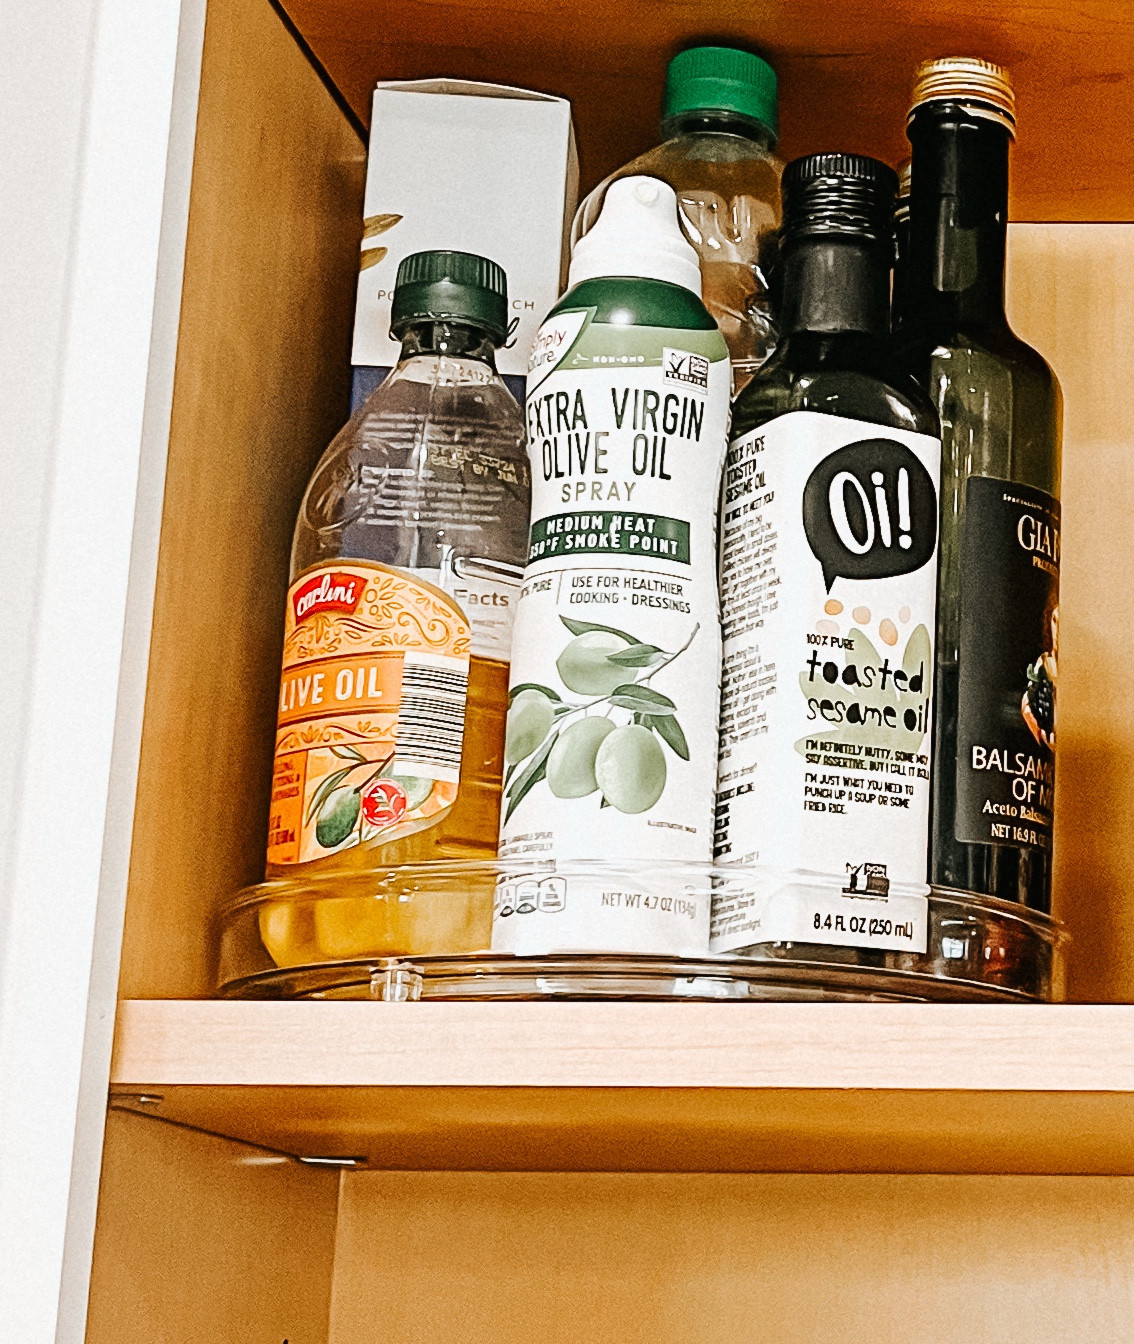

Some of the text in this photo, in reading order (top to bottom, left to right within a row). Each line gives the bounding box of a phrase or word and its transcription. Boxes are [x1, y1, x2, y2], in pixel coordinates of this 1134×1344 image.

[528, 388, 588, 446] EXTRA
[611, 387, 705, 442] VIRGIN
[542, 431, 610, 482] OLIVE
[632, 433, 672, 481] OIL
[745, 435, 766, 456] PURE
[561, 481, 637, 503] SPRAY
[828, 466, 913, 555] Oi!
[546, 515, 656, 535] MEDIUM HEAT
[564, 533, 621, 549] SMOKE
[629, 534, 678, 555] POINT
[296, 573, 356, 617] carlini
[453, 588, 510, 607] Facts
[571, 576, 684, 597] USE FOR HEALTHIER
[569, 592, 692, 614] COOKING DRESSINGS
[830, 636, 855, 651] PURE
[806, 650, 924, 695] toasted
[335, 667, 383, 701] OIL
[807, 697, 929, 734] sesame oil
[819, 775, 840, 786] JUST
[843, 777, 864, 789] WHAT
[867, 779, 883, 792] YOU
[885, 782, 902, 794] NEED
[1012, 777, 1036, 803] OF
[804, 786, 910, 809] PUNCH UP SOUP OR SOME
[804, 801, 827, 812] FRIED
[982, 799, 1018, 817] Aceto
[991, 822, 1011, 839] NET
[602, 892, 673, 912] NET WT 4.7 OZ
[813, 913, 832, 929] 8.4
[835, 915, 846, 931] FL
[850, 917, 866, 933] OZ
[869, 918, 892, 936] (250
